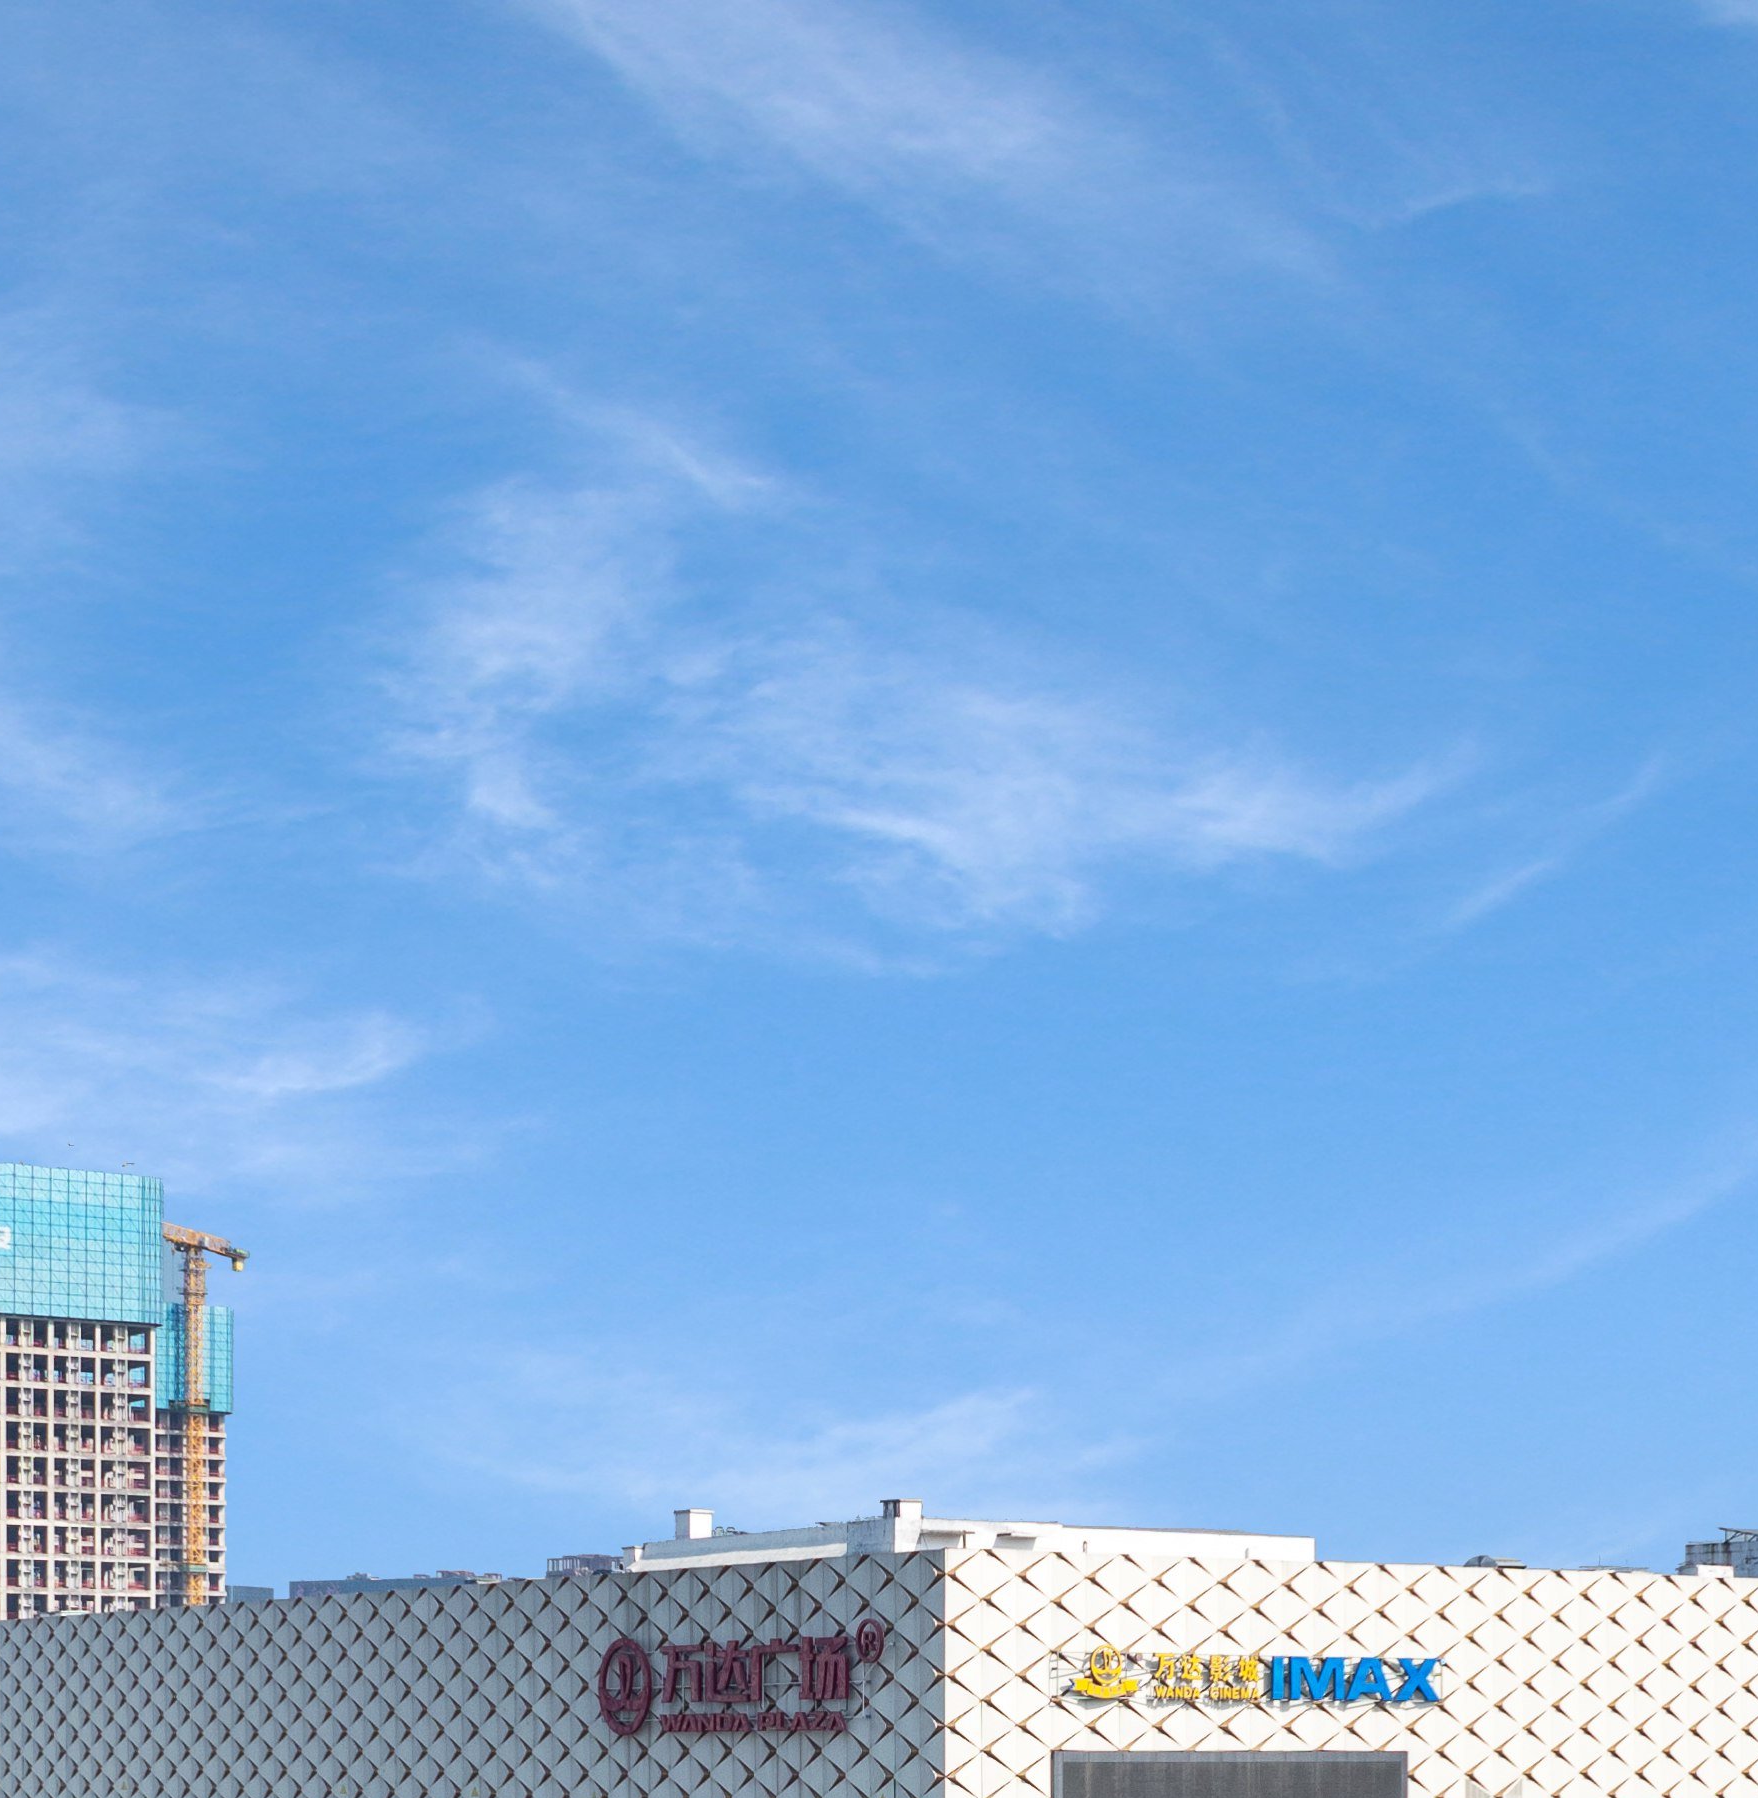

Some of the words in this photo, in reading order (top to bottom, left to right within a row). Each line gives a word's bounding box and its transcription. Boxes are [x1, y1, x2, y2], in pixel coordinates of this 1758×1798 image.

[660, 1636, 851, 1703] 万达广场
[1152, 1652, 1260, 1683] 万达影城
[1271, 1656, 1440, 1701] IMAX
[1154, 1685, 1201, 1700] WANDA
[1209, 1685, 1260, 1700] CINEMA
[659, 1712, 752, 1733] WANDA
[757, 1711, 848, 1733] PLAZA
